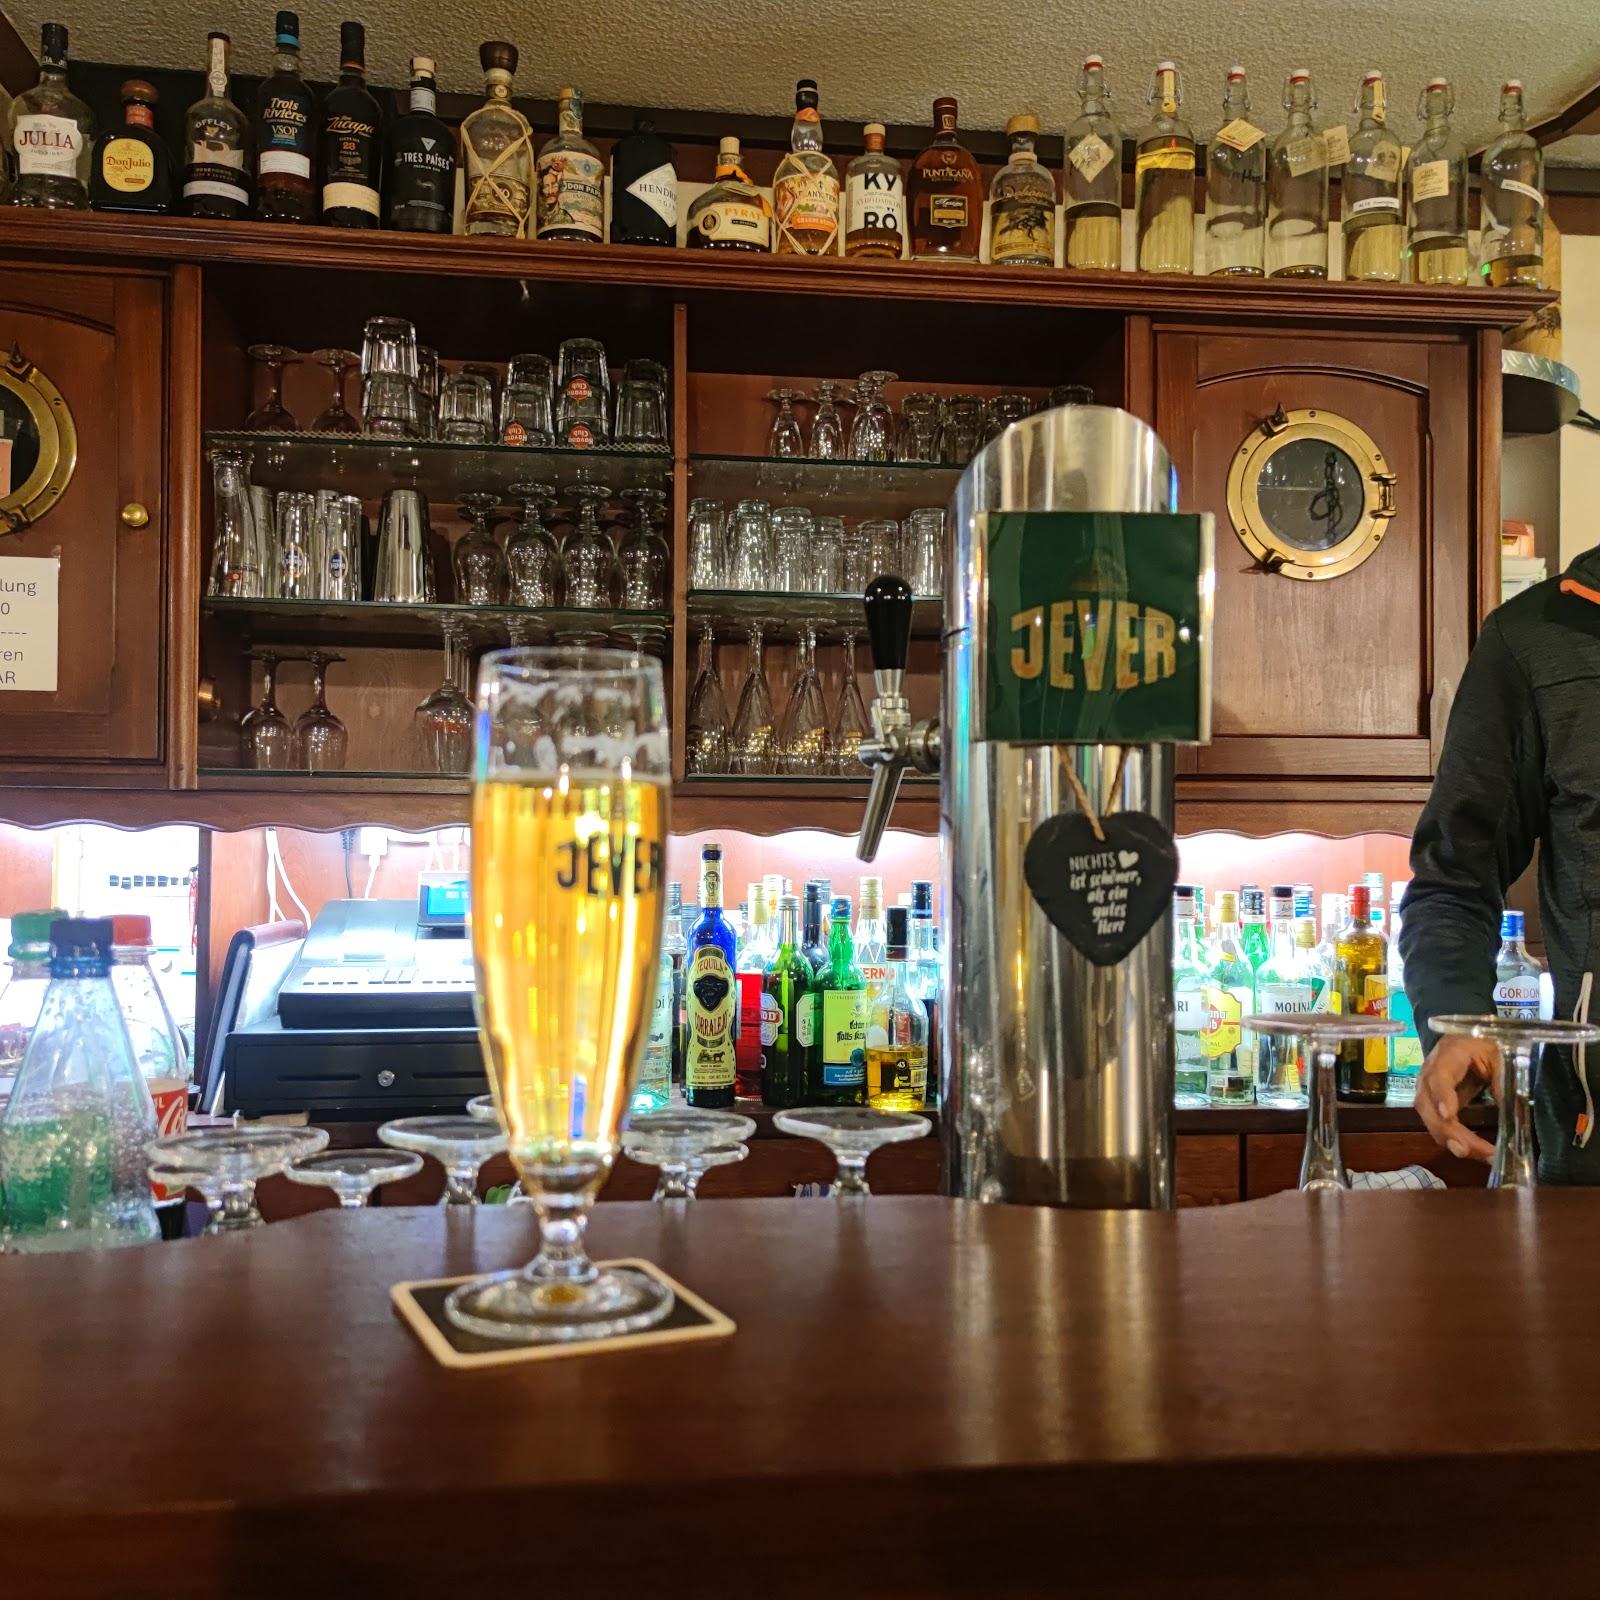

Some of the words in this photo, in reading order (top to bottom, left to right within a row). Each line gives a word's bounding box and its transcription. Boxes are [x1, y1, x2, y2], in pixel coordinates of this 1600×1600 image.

[271, 97, 300, 111] Trois
[195, 118, 233, 131] OFFLEY
[271, 124, 298, 136] VSOP
[19, 130, 75, 150] JULIA
[342, 141, 356, 151] 23
[403, 152, 423, 163] TRES
[425, 153, 450, 171] PAÍSES
[567, 182, 585, 193] DON
[863, 172, 897, 191] KY
[724, 206, 761, 219] PYRAT
[566, 390, 593, 398] Havana
[508, 427, 522, 435] Club
[573, 429, 589, 437] Club
[1011, 599, 1177, 692] JEVER
[1069, 851, 1117, 871] NICHTS
[1069, 873, 1087, 890] ist
[1087, 889, 1105, 904] als
[1107, 885, 1128, 899] ein
[1092, 902, 1127, 923] gutes
[697, 958, 725, 975] TEQUILA
